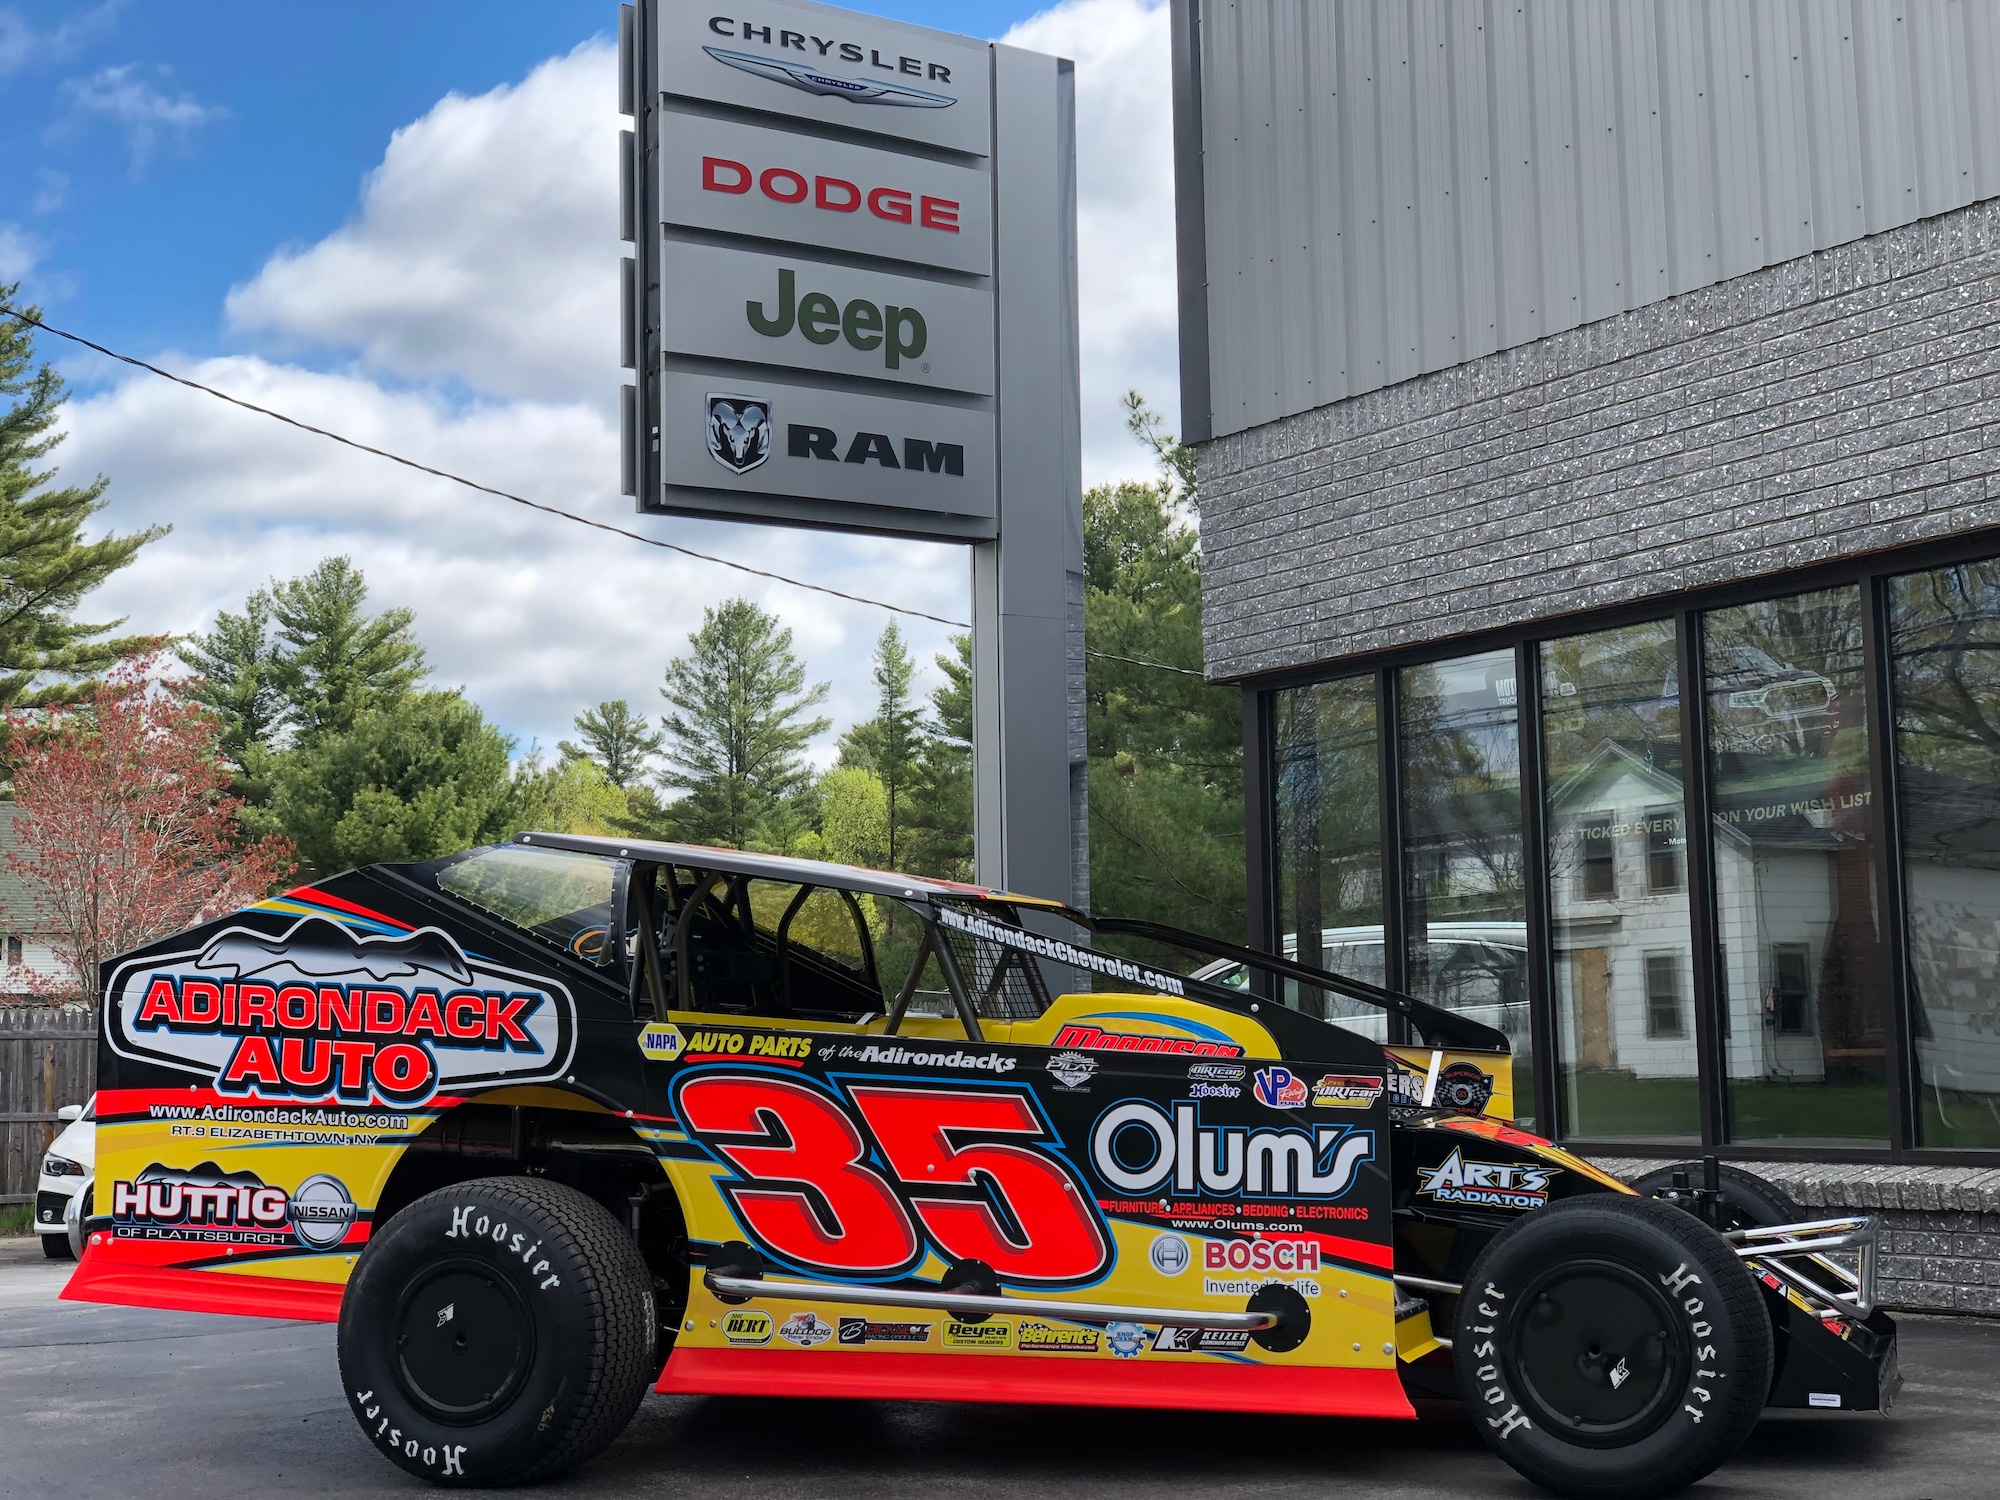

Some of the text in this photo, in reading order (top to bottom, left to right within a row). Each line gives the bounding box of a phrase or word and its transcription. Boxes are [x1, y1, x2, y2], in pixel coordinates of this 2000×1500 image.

[708, 16, 952, 84] CHRYSLER
[702, 156, 960, 234] DODGE
[746, 268, 927, 369] Jeep
[787, 423, 964, 477] RAM
[1745, 804, 1787, 822] YOUR
[1790, 797, 1836, 816] WISH
[1839, 791, 1872, 808] LIST
[1578, 824, 1631, 841] TICKED
[1634, 817, 1682, 836] EVERY
[940, 907, 1185, 996] www.AdirondackChevrolet.com
[135, 976, 534, 1045] ADIRONDACK
[646, 1033, 678, 1051] NAPA
[686, 1031, 1017, 1073] AUTO PARTS of the Adirondacks
[222, 1034, 434, 1093] AUTO
[1444, 1070, 1482, 1081] SUPERIOR
[1189, 1082, 1241, 1098] Hoosier
[1254, 1066, 1293, 1107] VP
[149, 1104, 409, 1129] www.AdirondackAuto.com
[171, 1125, 381, 1146] RT.9 ELIZABETHTOWN, NY
[680, 1075, 1108, 1282] 35
[114, 1182, 289, 1223] HUTTIG
[1109, 1200, 1369, 1220] FURNITURE APPLIANCES BEDDING ELECTRONICS
[1435, 1187, 1546, 1208] RADIATOR
[293, 1204, 351, 1219] NISSAN
[1170, 1218, 1304, 1232] www.Olums.com
[117, 1227, 286, 1245] OF PLATTSBURGH
[444, 1204, 561, 1291] Hoosier
[1205, 1242, 1319, 1271] BOSCH
[1297, 1280, 1319, 1295] life
[726, 1319, 770, 1334] BERT
[780, 1327, 832, 1336] BULLDOG
[948, 1324, 1008, 1338] Beyea
[1020, 1328, 1099, 1344] Behrent's
[1201, 1331, 1250, 1341] KEIZER
[1658, 1262, 1728, 1424] Hoosier
[1465, 1281, 1533, 1440] Hoosier
[356, 1388, 468, 1476] Hoosier
